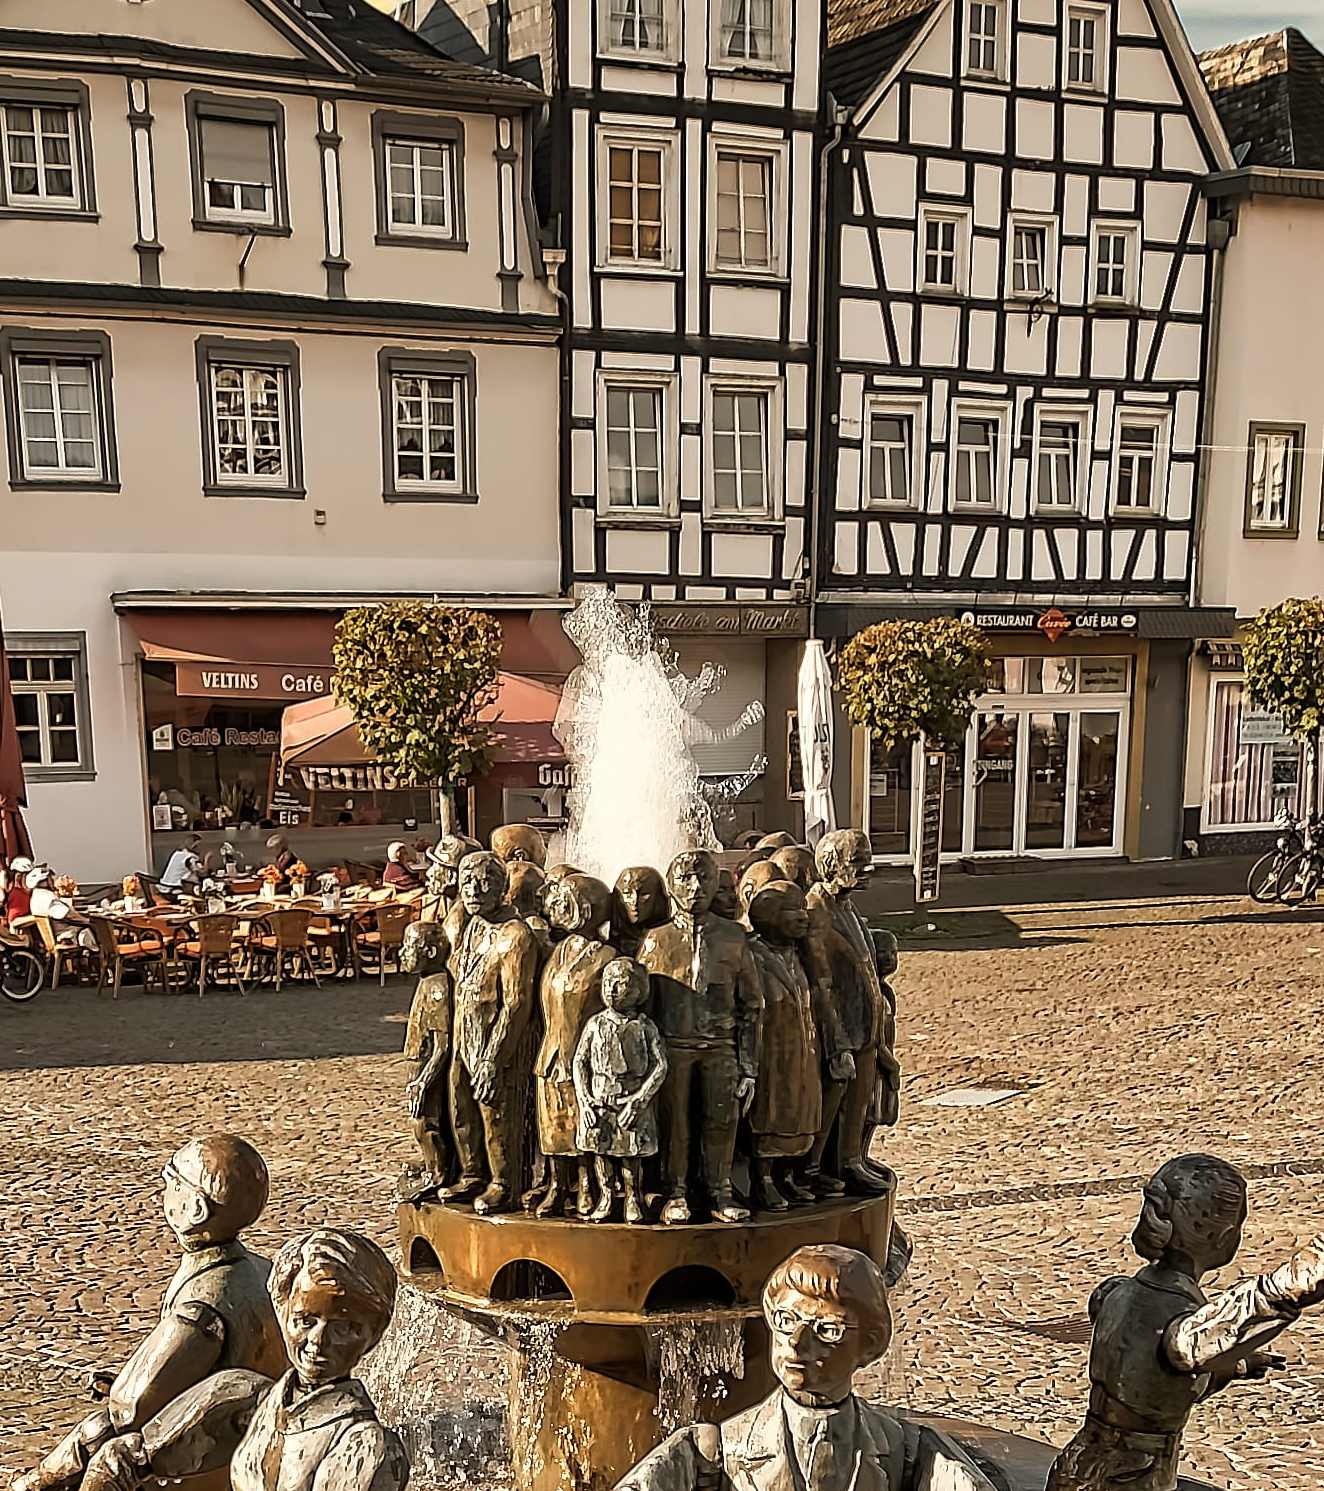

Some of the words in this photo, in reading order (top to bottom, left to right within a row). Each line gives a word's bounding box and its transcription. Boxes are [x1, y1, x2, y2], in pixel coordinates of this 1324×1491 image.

[745, 609, 799, 630] Markt
[977, 614, 1034, 627] RESTAURANT
[1075, 613, 1099, 628] CAFÉ
[1101, 616, 1118, 627] BAR
[201, 671, 259, 690] VELTINS
[281, 673, 324, 693] Café
[176, 727, 221, 747] Café
[225, 727, 281, 746] Resta
[300, 765, 397, 791] VELTINS
[279, 811, 300, 825] Eis
